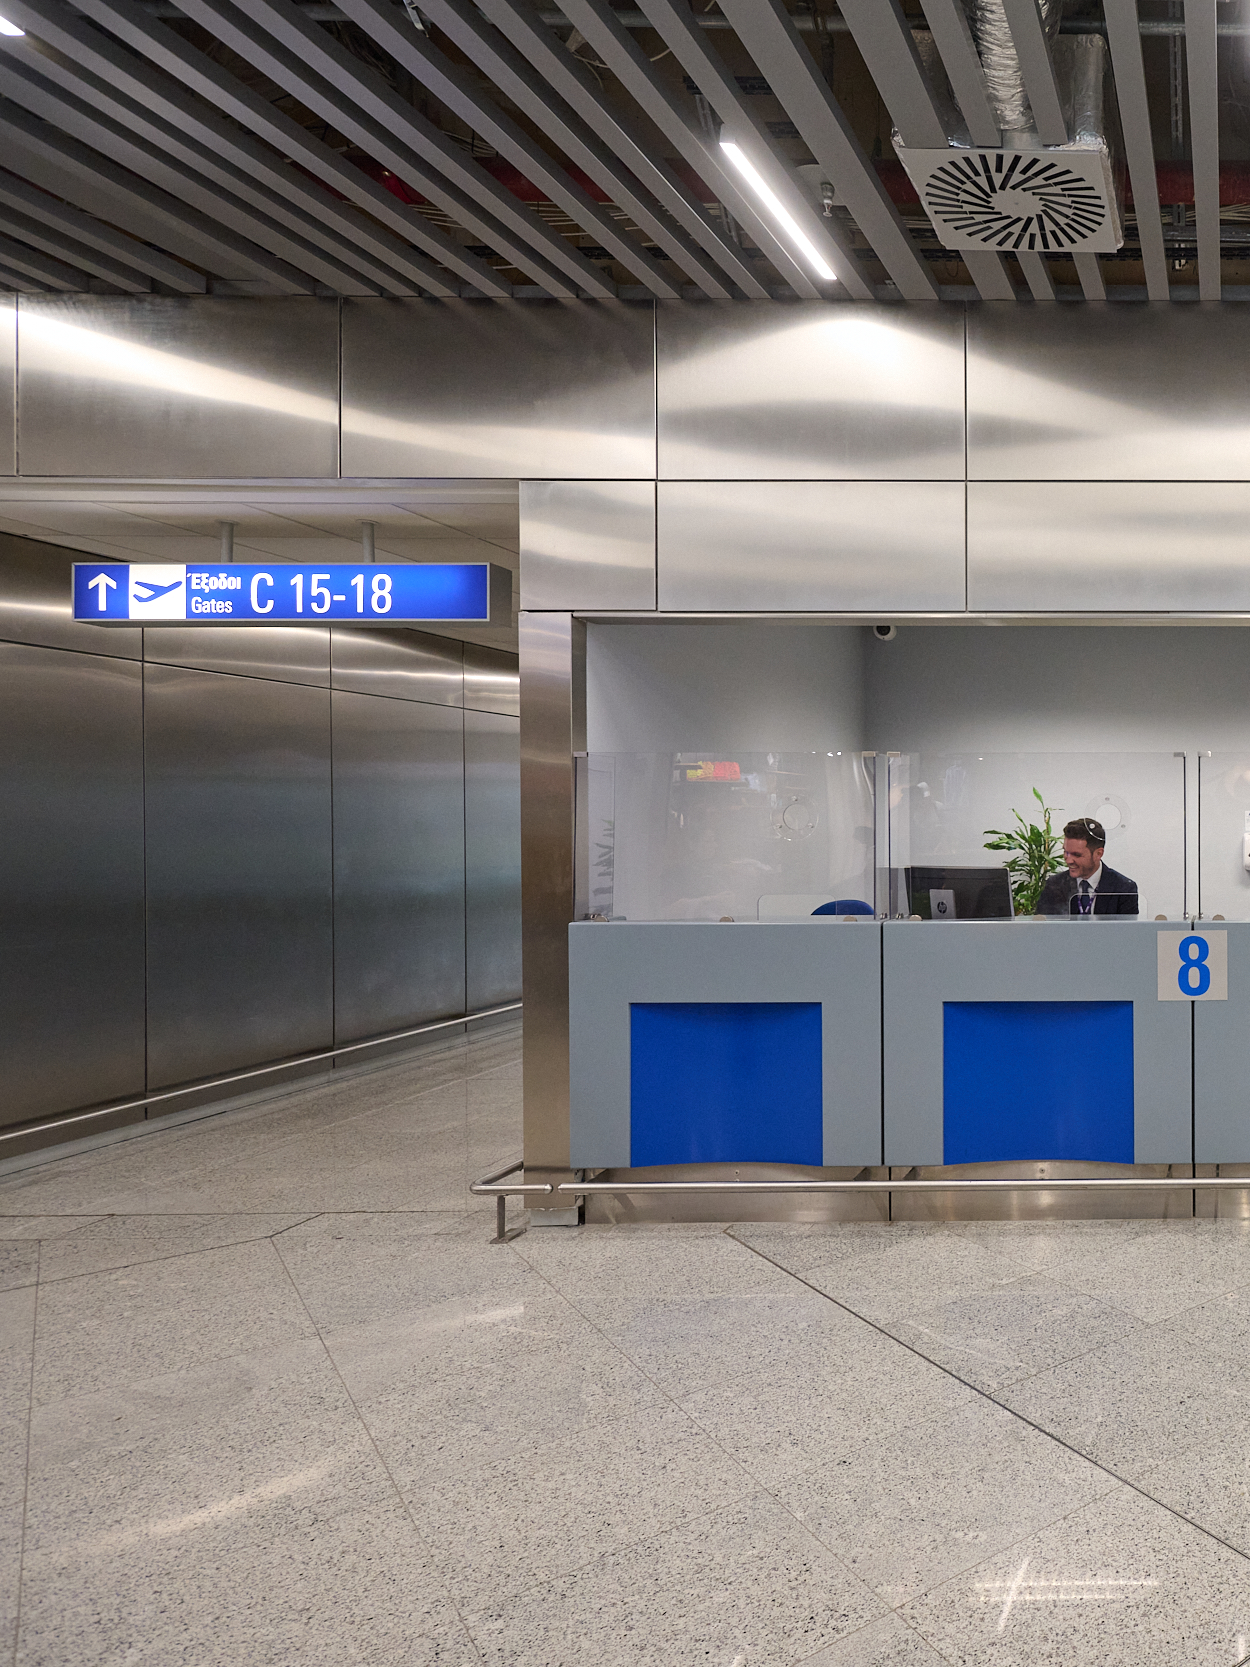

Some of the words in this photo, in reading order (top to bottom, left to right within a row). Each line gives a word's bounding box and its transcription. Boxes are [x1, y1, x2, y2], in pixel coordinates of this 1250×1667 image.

[186, 573, 242, 593] Έξοδοι
[250, 572, 275, 614] C
[289, 572, 393, 614] 15-18
[190, 596, 233, 614] Gates
[1177, 935, 1211, 996] 8
